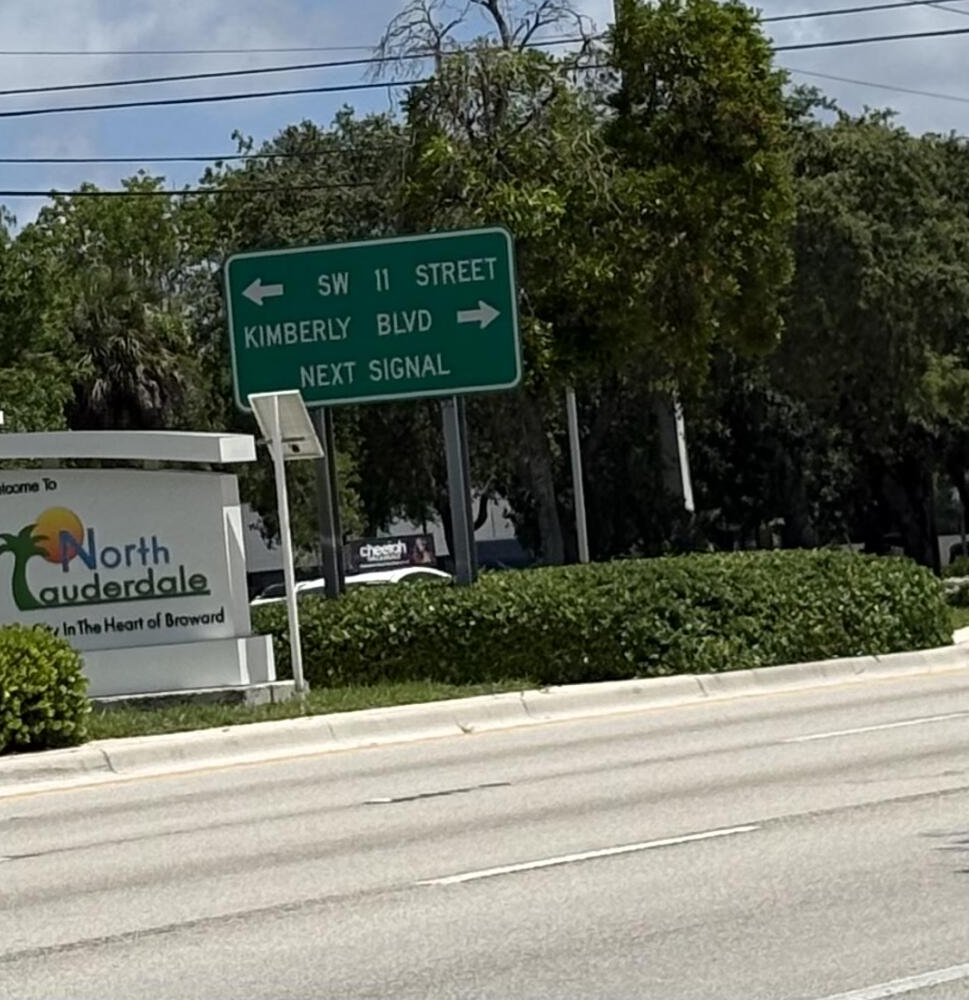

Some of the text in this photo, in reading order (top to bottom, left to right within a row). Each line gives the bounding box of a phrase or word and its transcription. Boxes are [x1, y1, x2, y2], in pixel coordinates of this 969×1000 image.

[318, 257, 497, 296] SW 11 STREET
[244, 310, 432, 348] KIMBERLY BLVD
[300, 353, 451, 388] NEXT SIGNAL
[42, 478, 57, 491] To
[58, 527, 170, 573] North
[64, 621, 75, 637] In
[77, 617, 101, 635] The
[104, 616, 143, 632] Heart
[147, 612, 162, 629] of
[165, 606, 225, 628] Broward
